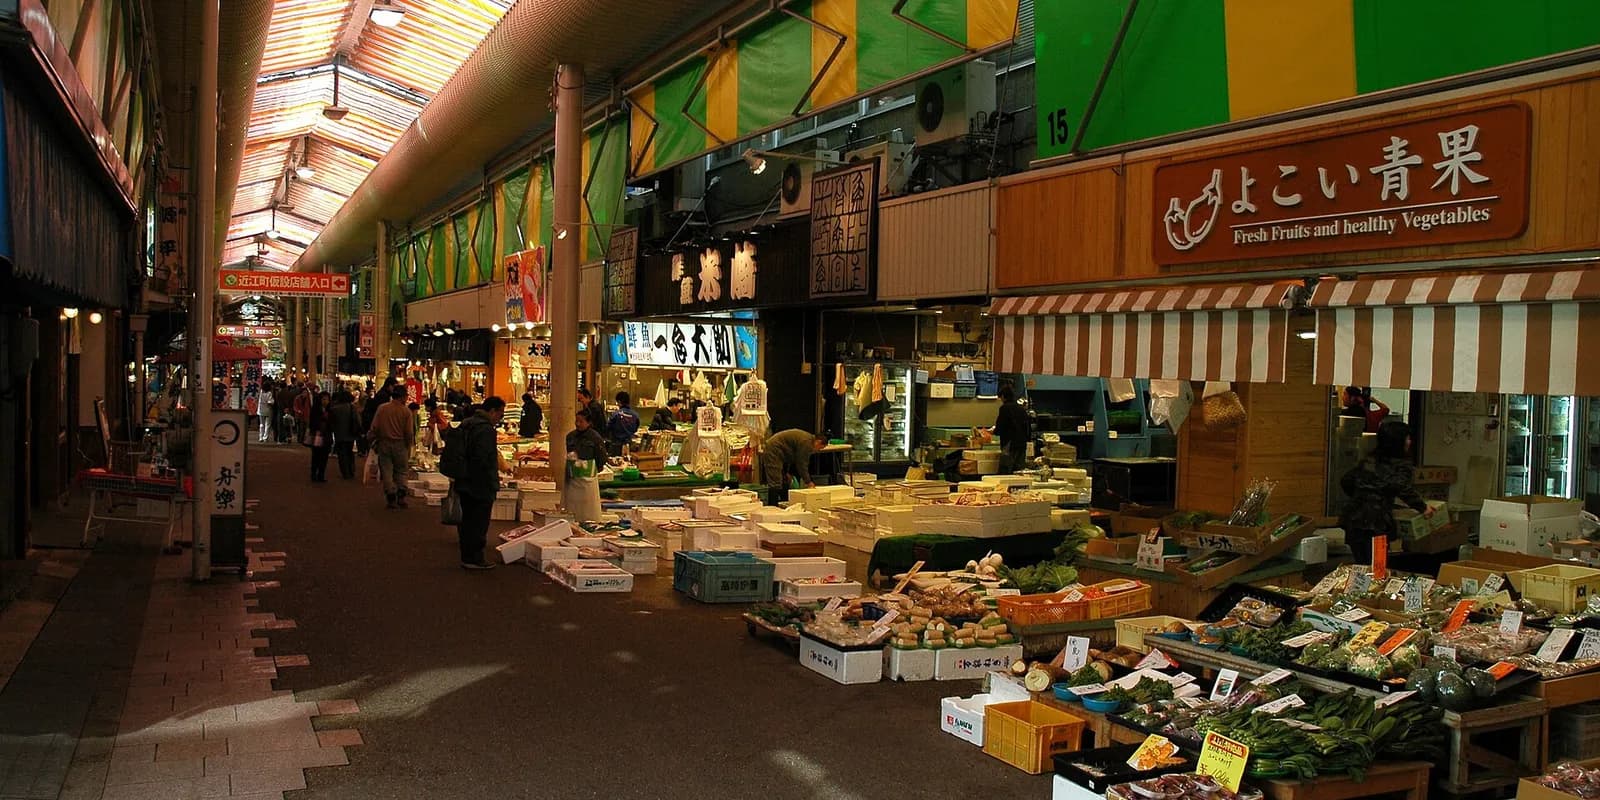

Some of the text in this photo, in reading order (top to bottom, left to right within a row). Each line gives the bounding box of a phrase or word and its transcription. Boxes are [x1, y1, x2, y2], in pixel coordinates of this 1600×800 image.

[1047, 108, 1069, 147] 15
[1232, 124, 1489, 214] よこい青果
[1234, 205, 1490, 244] Fresh Fruits and healthy Vegetables
[238, 274, 330, 289] 近江町仮設店舗入口
